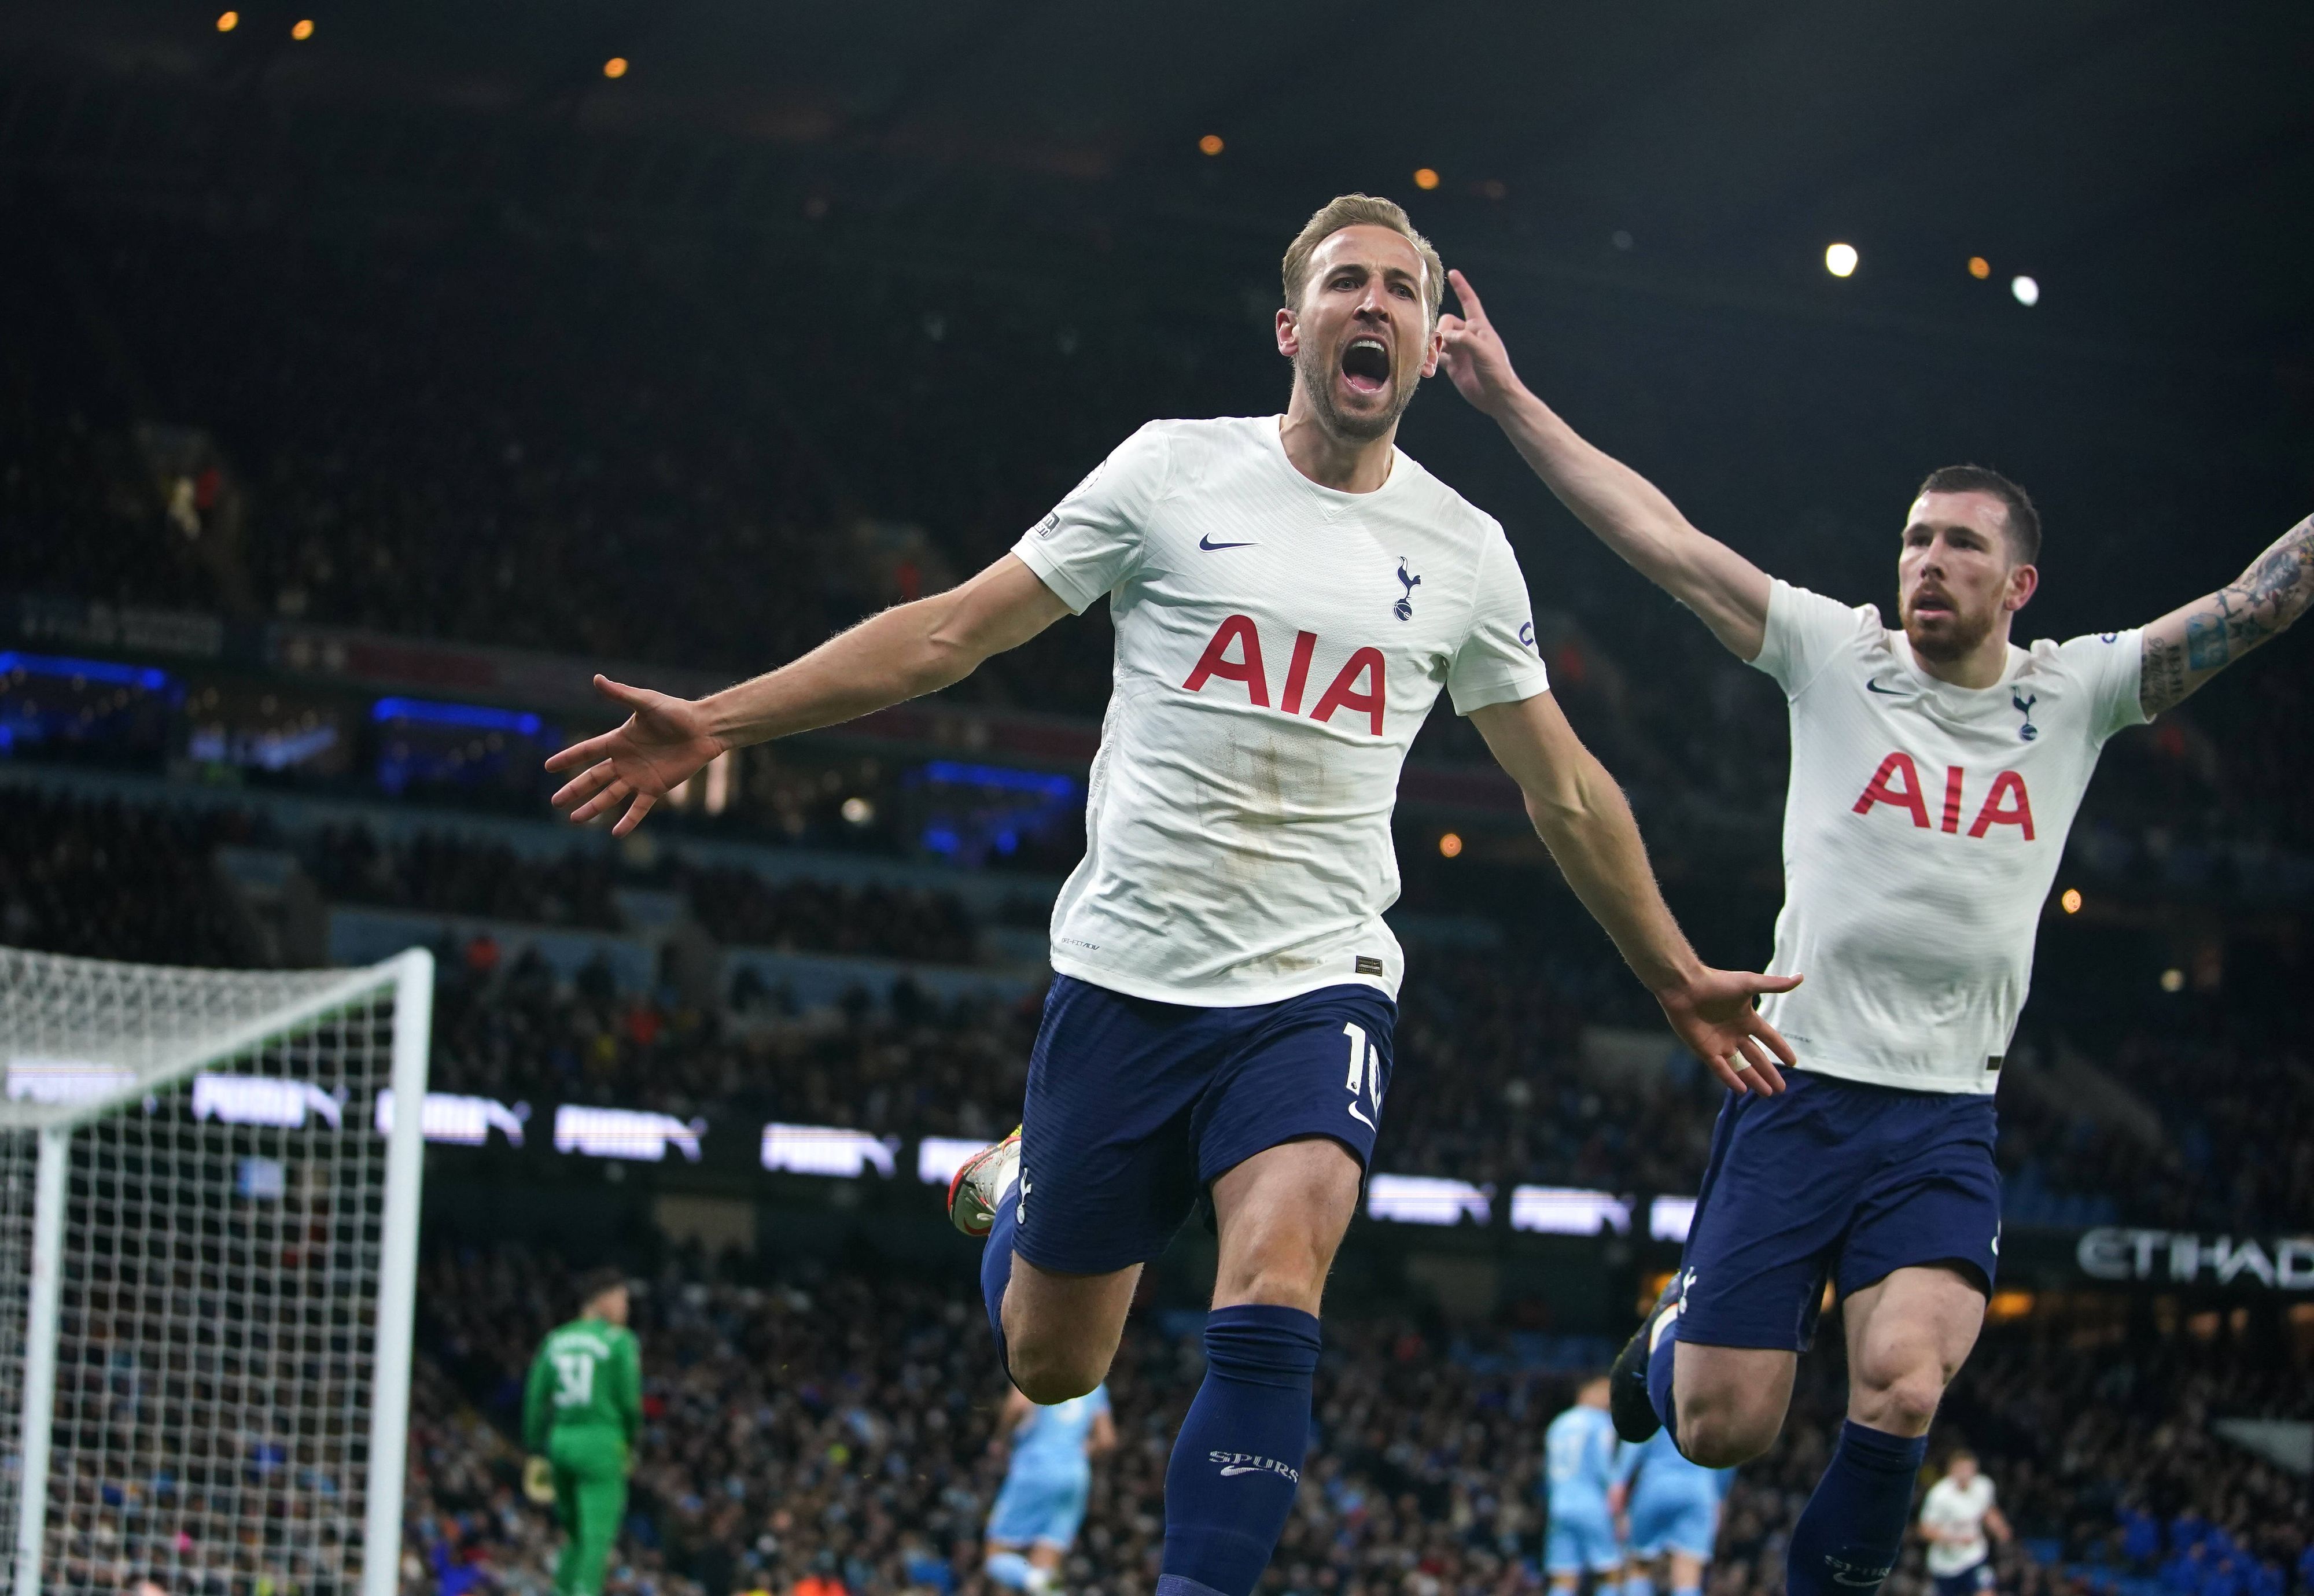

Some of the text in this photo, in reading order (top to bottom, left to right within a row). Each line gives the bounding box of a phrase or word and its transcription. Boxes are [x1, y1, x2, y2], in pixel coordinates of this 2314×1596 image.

[1182, 614, 1385, 736] AIA
[1853, 751, 2035, 841] AIA
[2076, 1225, 2314, 1289] ETIHAD
[551, 1352, 595, 1407] 31
[1208, 1450, 1299, 1483] SPURS
